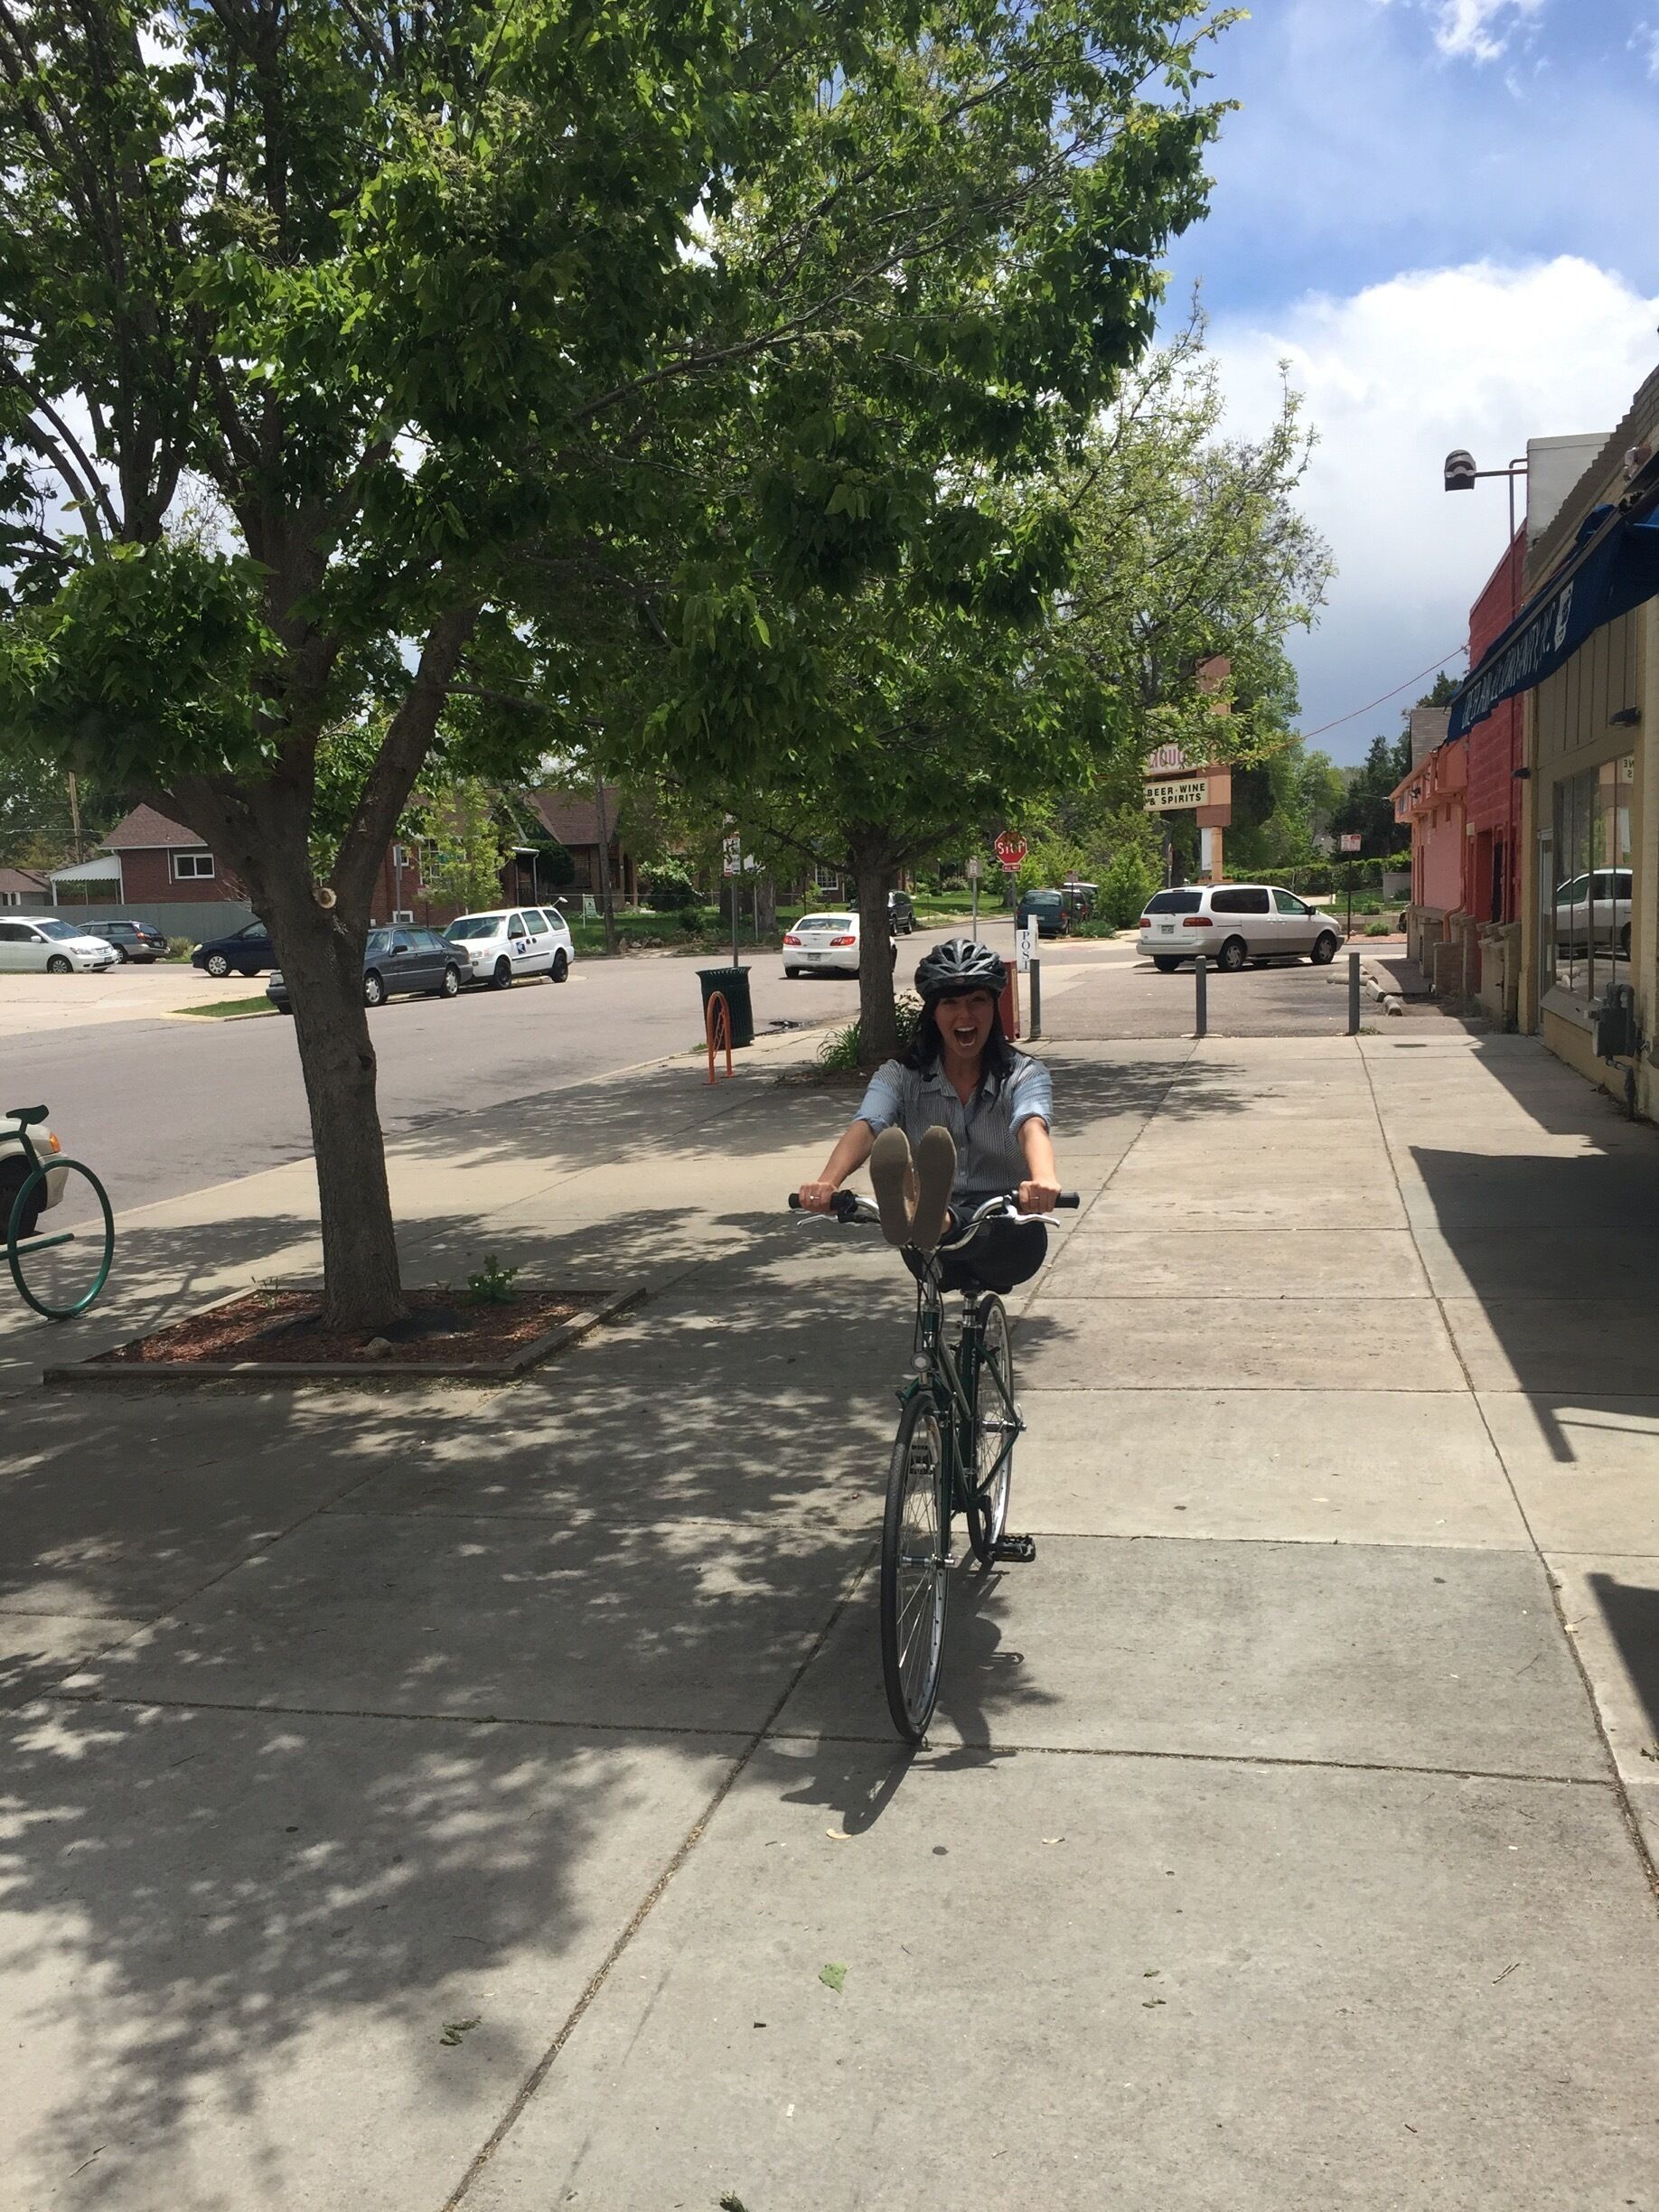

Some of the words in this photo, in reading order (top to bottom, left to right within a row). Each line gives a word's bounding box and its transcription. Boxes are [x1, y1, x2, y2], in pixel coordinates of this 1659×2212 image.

[1148, 787, 1174, 797] BEER
[1179, 783, 1205, 793] WINE
[1149, 797, 1156, 806] &
[1161, 793, 1202, 805] SPIRITS
[1021, 931, 1031, 970] POST
